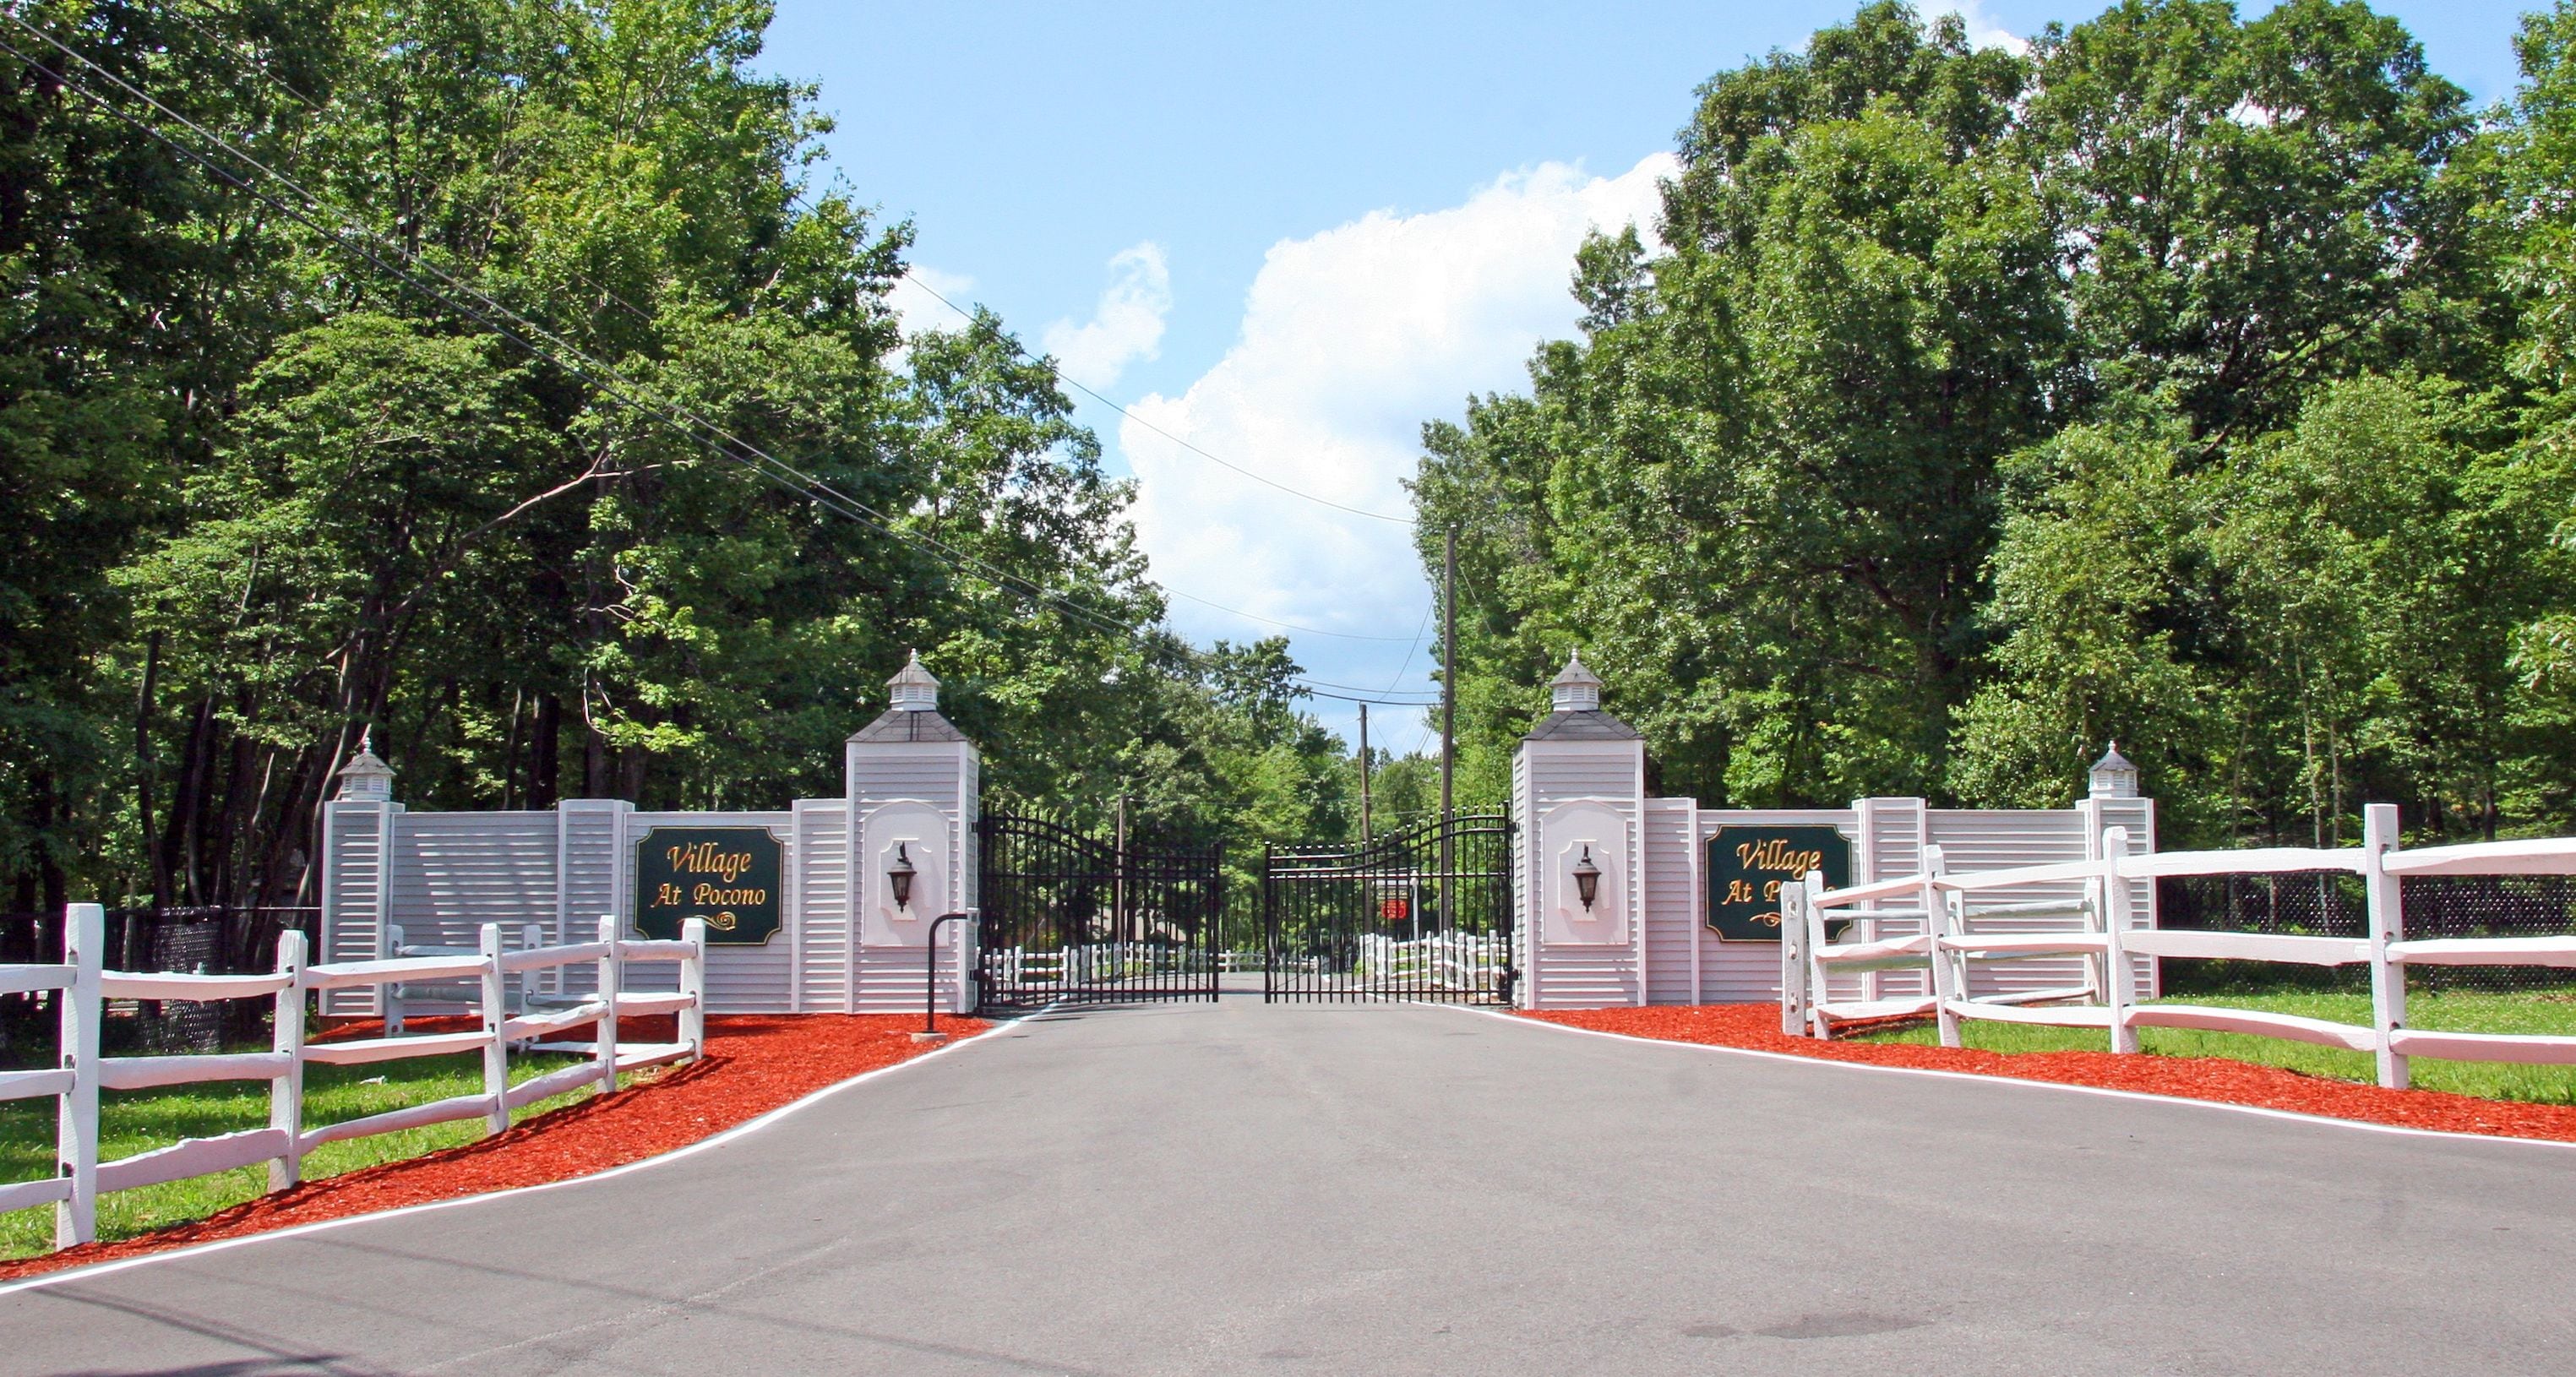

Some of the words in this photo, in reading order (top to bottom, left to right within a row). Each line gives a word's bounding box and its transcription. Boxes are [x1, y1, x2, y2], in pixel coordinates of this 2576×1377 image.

[667, 841, 752, 883] Village
[1736, 839, 1821, 880] Village
[650, 883, 682, 908] At
[694, 883, 765, 906] Pocono
[1721, 879, 1752, 905] At
